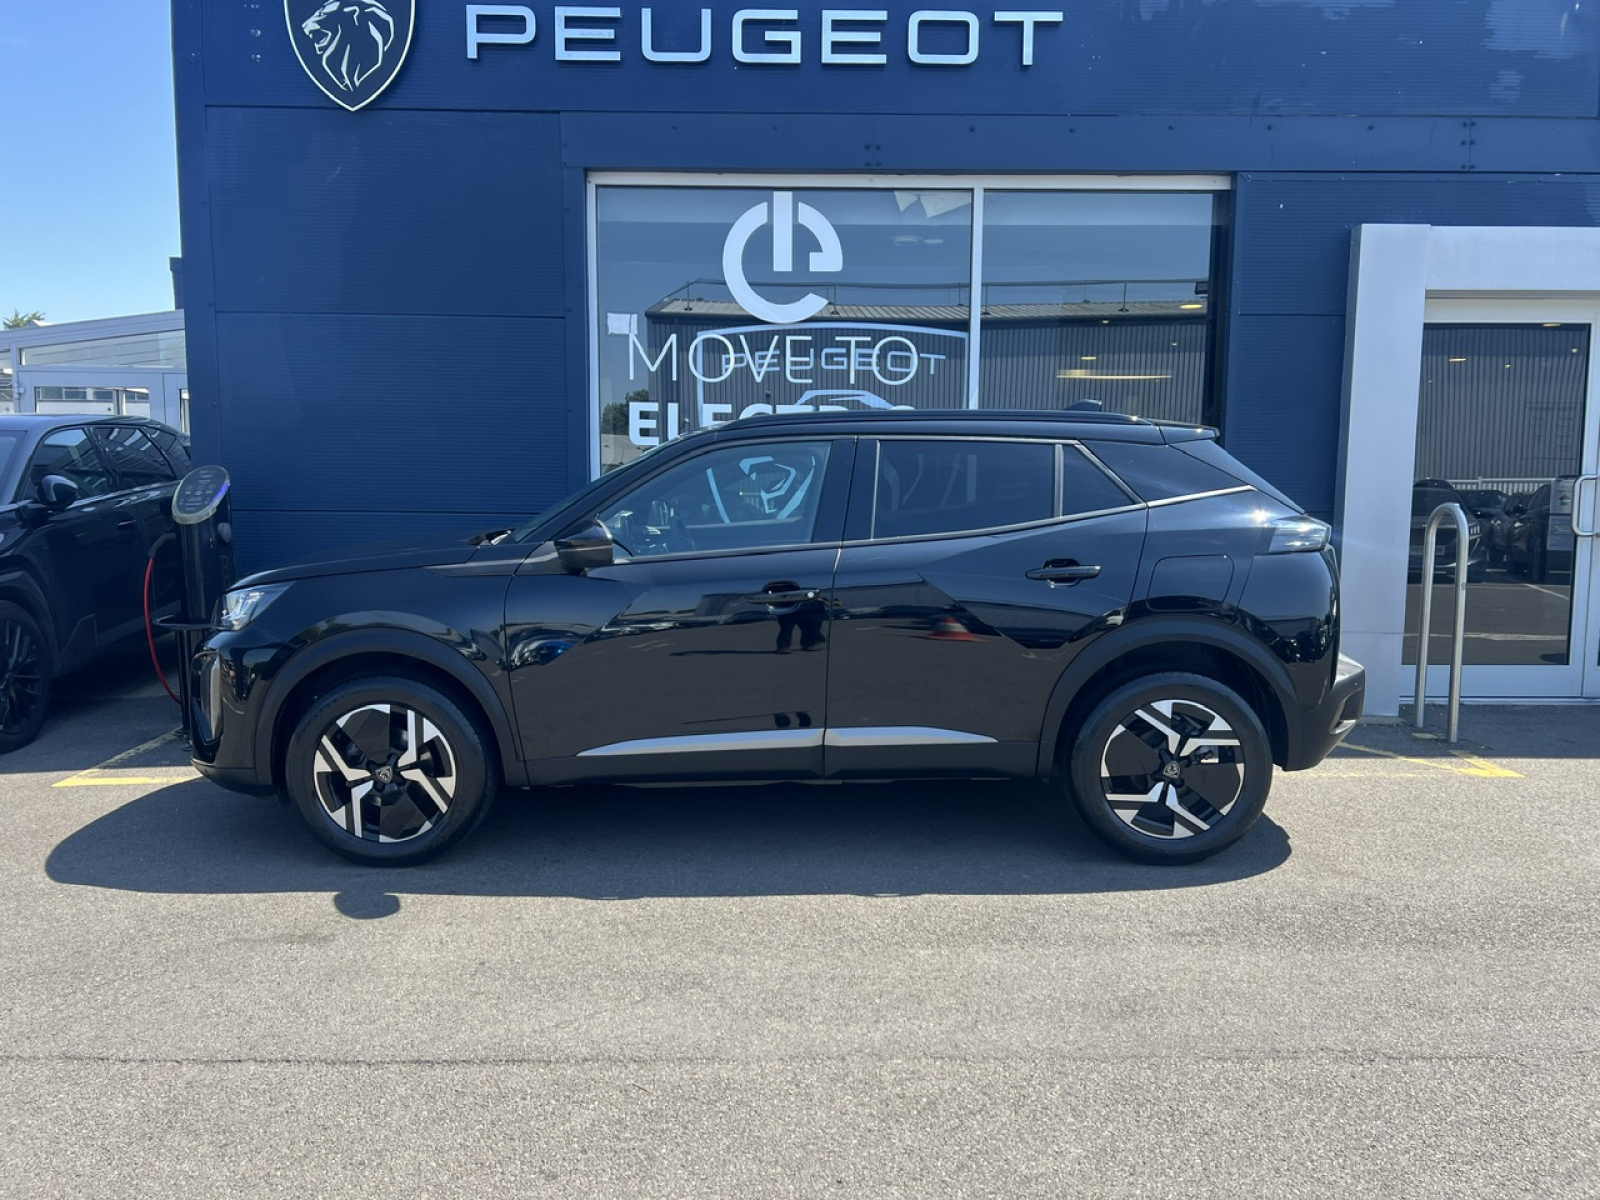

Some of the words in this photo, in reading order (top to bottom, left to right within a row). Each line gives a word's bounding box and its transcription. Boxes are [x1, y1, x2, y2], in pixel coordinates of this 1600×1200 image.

[466, 4, 1064, 66] PEUGEOT
[629, 333, 813, 385] MOVE
[834, 336, 919, 386] TO
[721, 347, 946, 375] PEUGEOT
